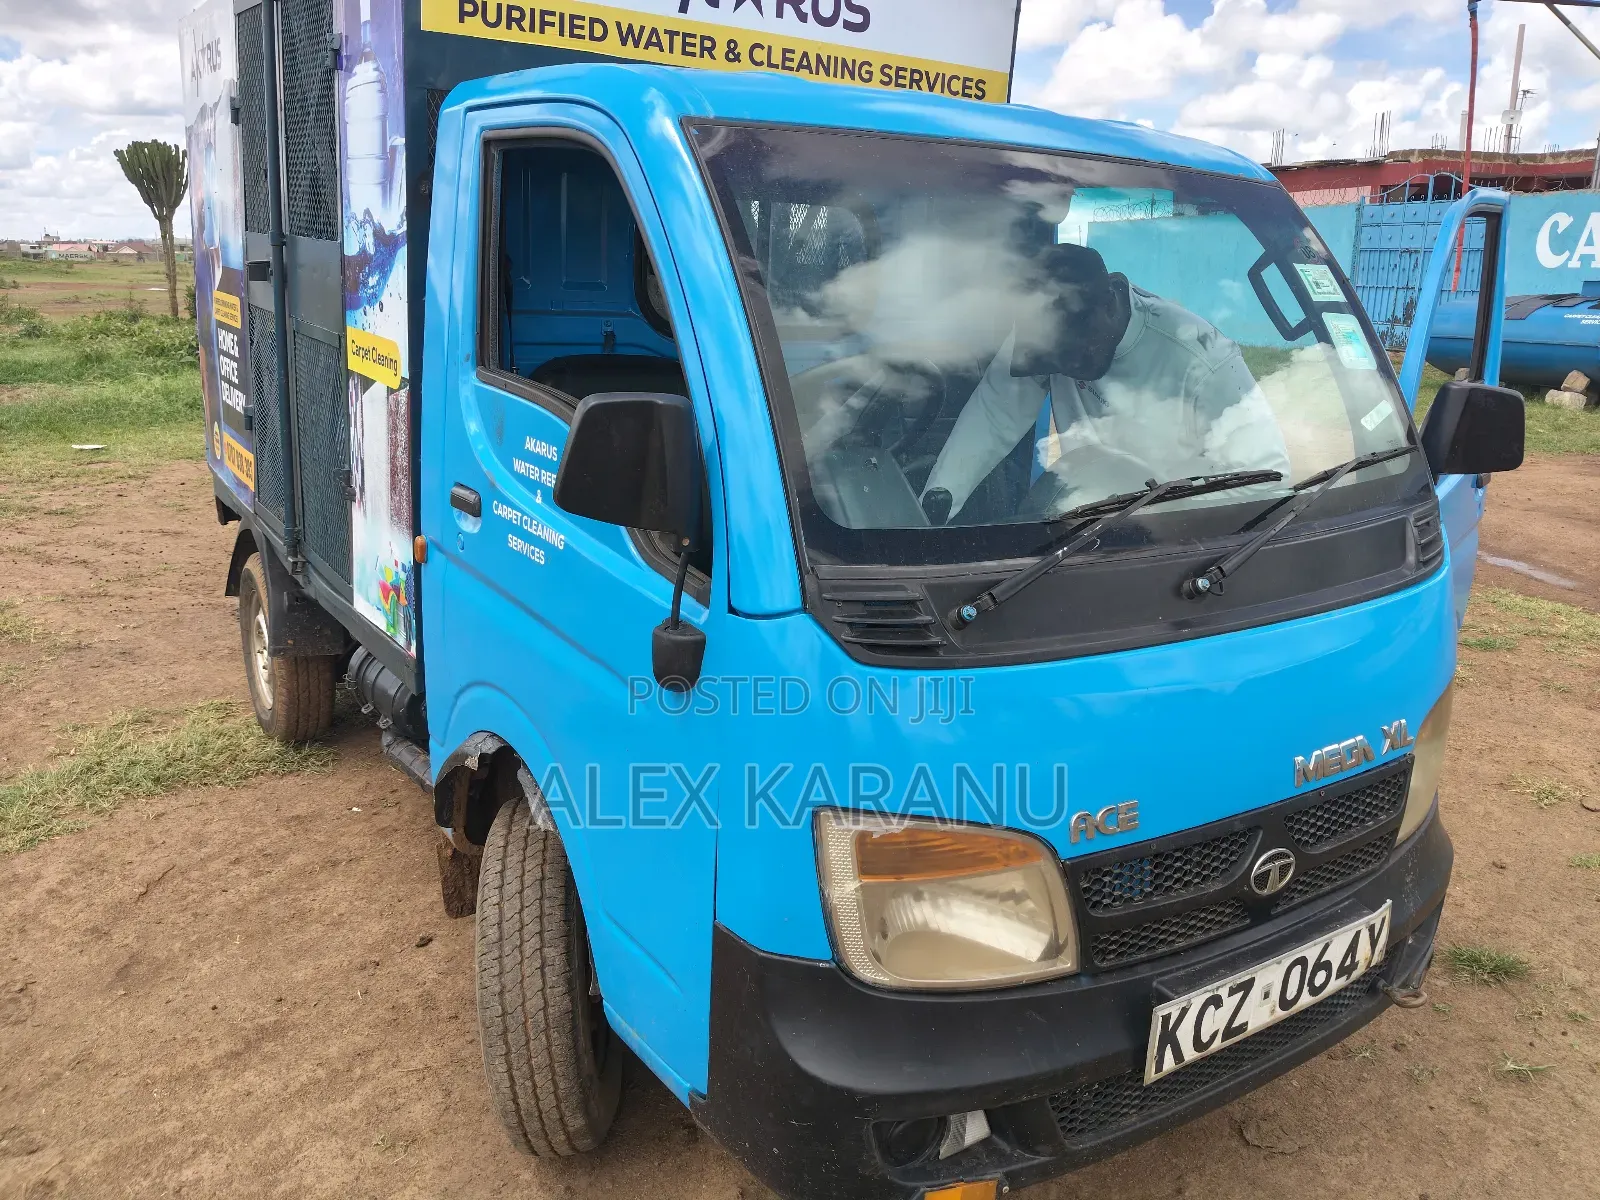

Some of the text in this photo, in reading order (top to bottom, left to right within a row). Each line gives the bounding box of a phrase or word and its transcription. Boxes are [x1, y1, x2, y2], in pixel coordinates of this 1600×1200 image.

[458, 0, 987, 101] PURIFIED WATER & CLEANING SERVICES
[218, 327, 234, 356] HOME
[351, 339, 398, 377] Carpet Cleaning
[220, 354, 239, 384] OFFICE
[221, 380, 246, 414] DELIVERY
[524, 436, 558, 462] AKARUS
[512, 457, 557, 489] WATER REF
[535, 489, 543, 504] &
[492, 500, 565, 550] CARPET CLEANING
[507, 533, 545, 565] SERVICES
[1294, 718, 1415, 789] MEGA XL
[1069, 800, 1139, 845] ACE
[1154, 915, 1388, 1075] KCZ 064Y
